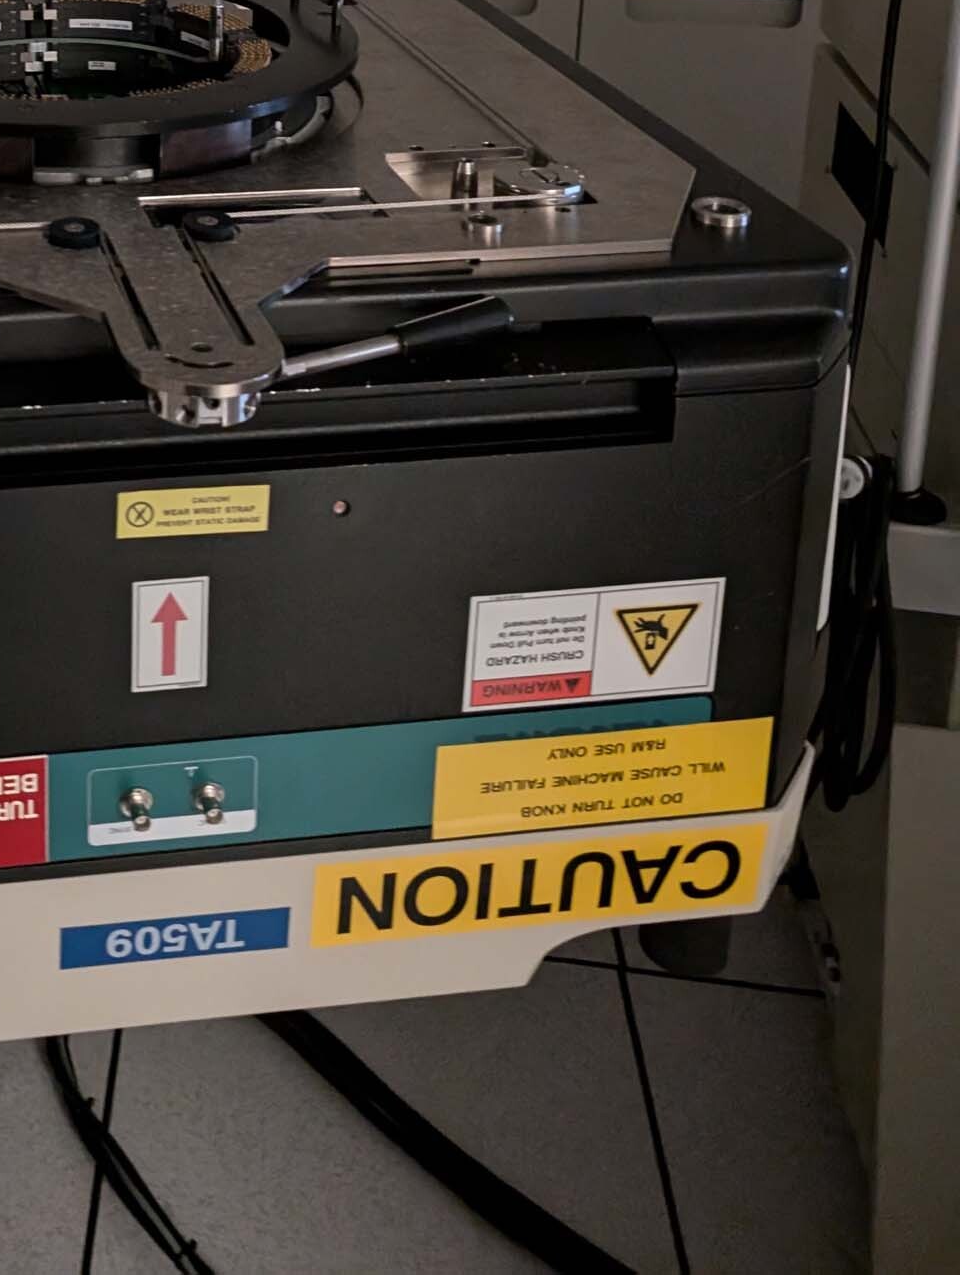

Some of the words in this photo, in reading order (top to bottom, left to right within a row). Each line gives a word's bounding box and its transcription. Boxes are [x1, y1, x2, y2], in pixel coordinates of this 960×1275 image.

[163, 508, 190, 516] WEAR
[225, 504, 256, 513] STRAP
[551, 615, 586, 624] pointing
[562, 626, 585, 634] Knob
[485, 654, 538, 667] HAZARD
[541, 650, 584, 662] CRUSH
[483, 680, 561, 697] WARNING
[592, 742, 625, 756] USE
[630, 738, 666, 753] R&M
[546, 746, 587, 761] ONLY
[630, 765, 682, 781] CAUSE
[687, 761, 726, 775] WILL
[480, 777, 546, 795] FAILURE
[553, 770, 625, 788] MACHINE
[571, 798, 615, 814] TURN
[623, 795, 654, 810] NOT
[659, 792, 683, 806] DO
[521, 803, 566, 817] KNOB
[336, 840, 742, 936] CAUTION
[106, 917, 245, 958] TA509
